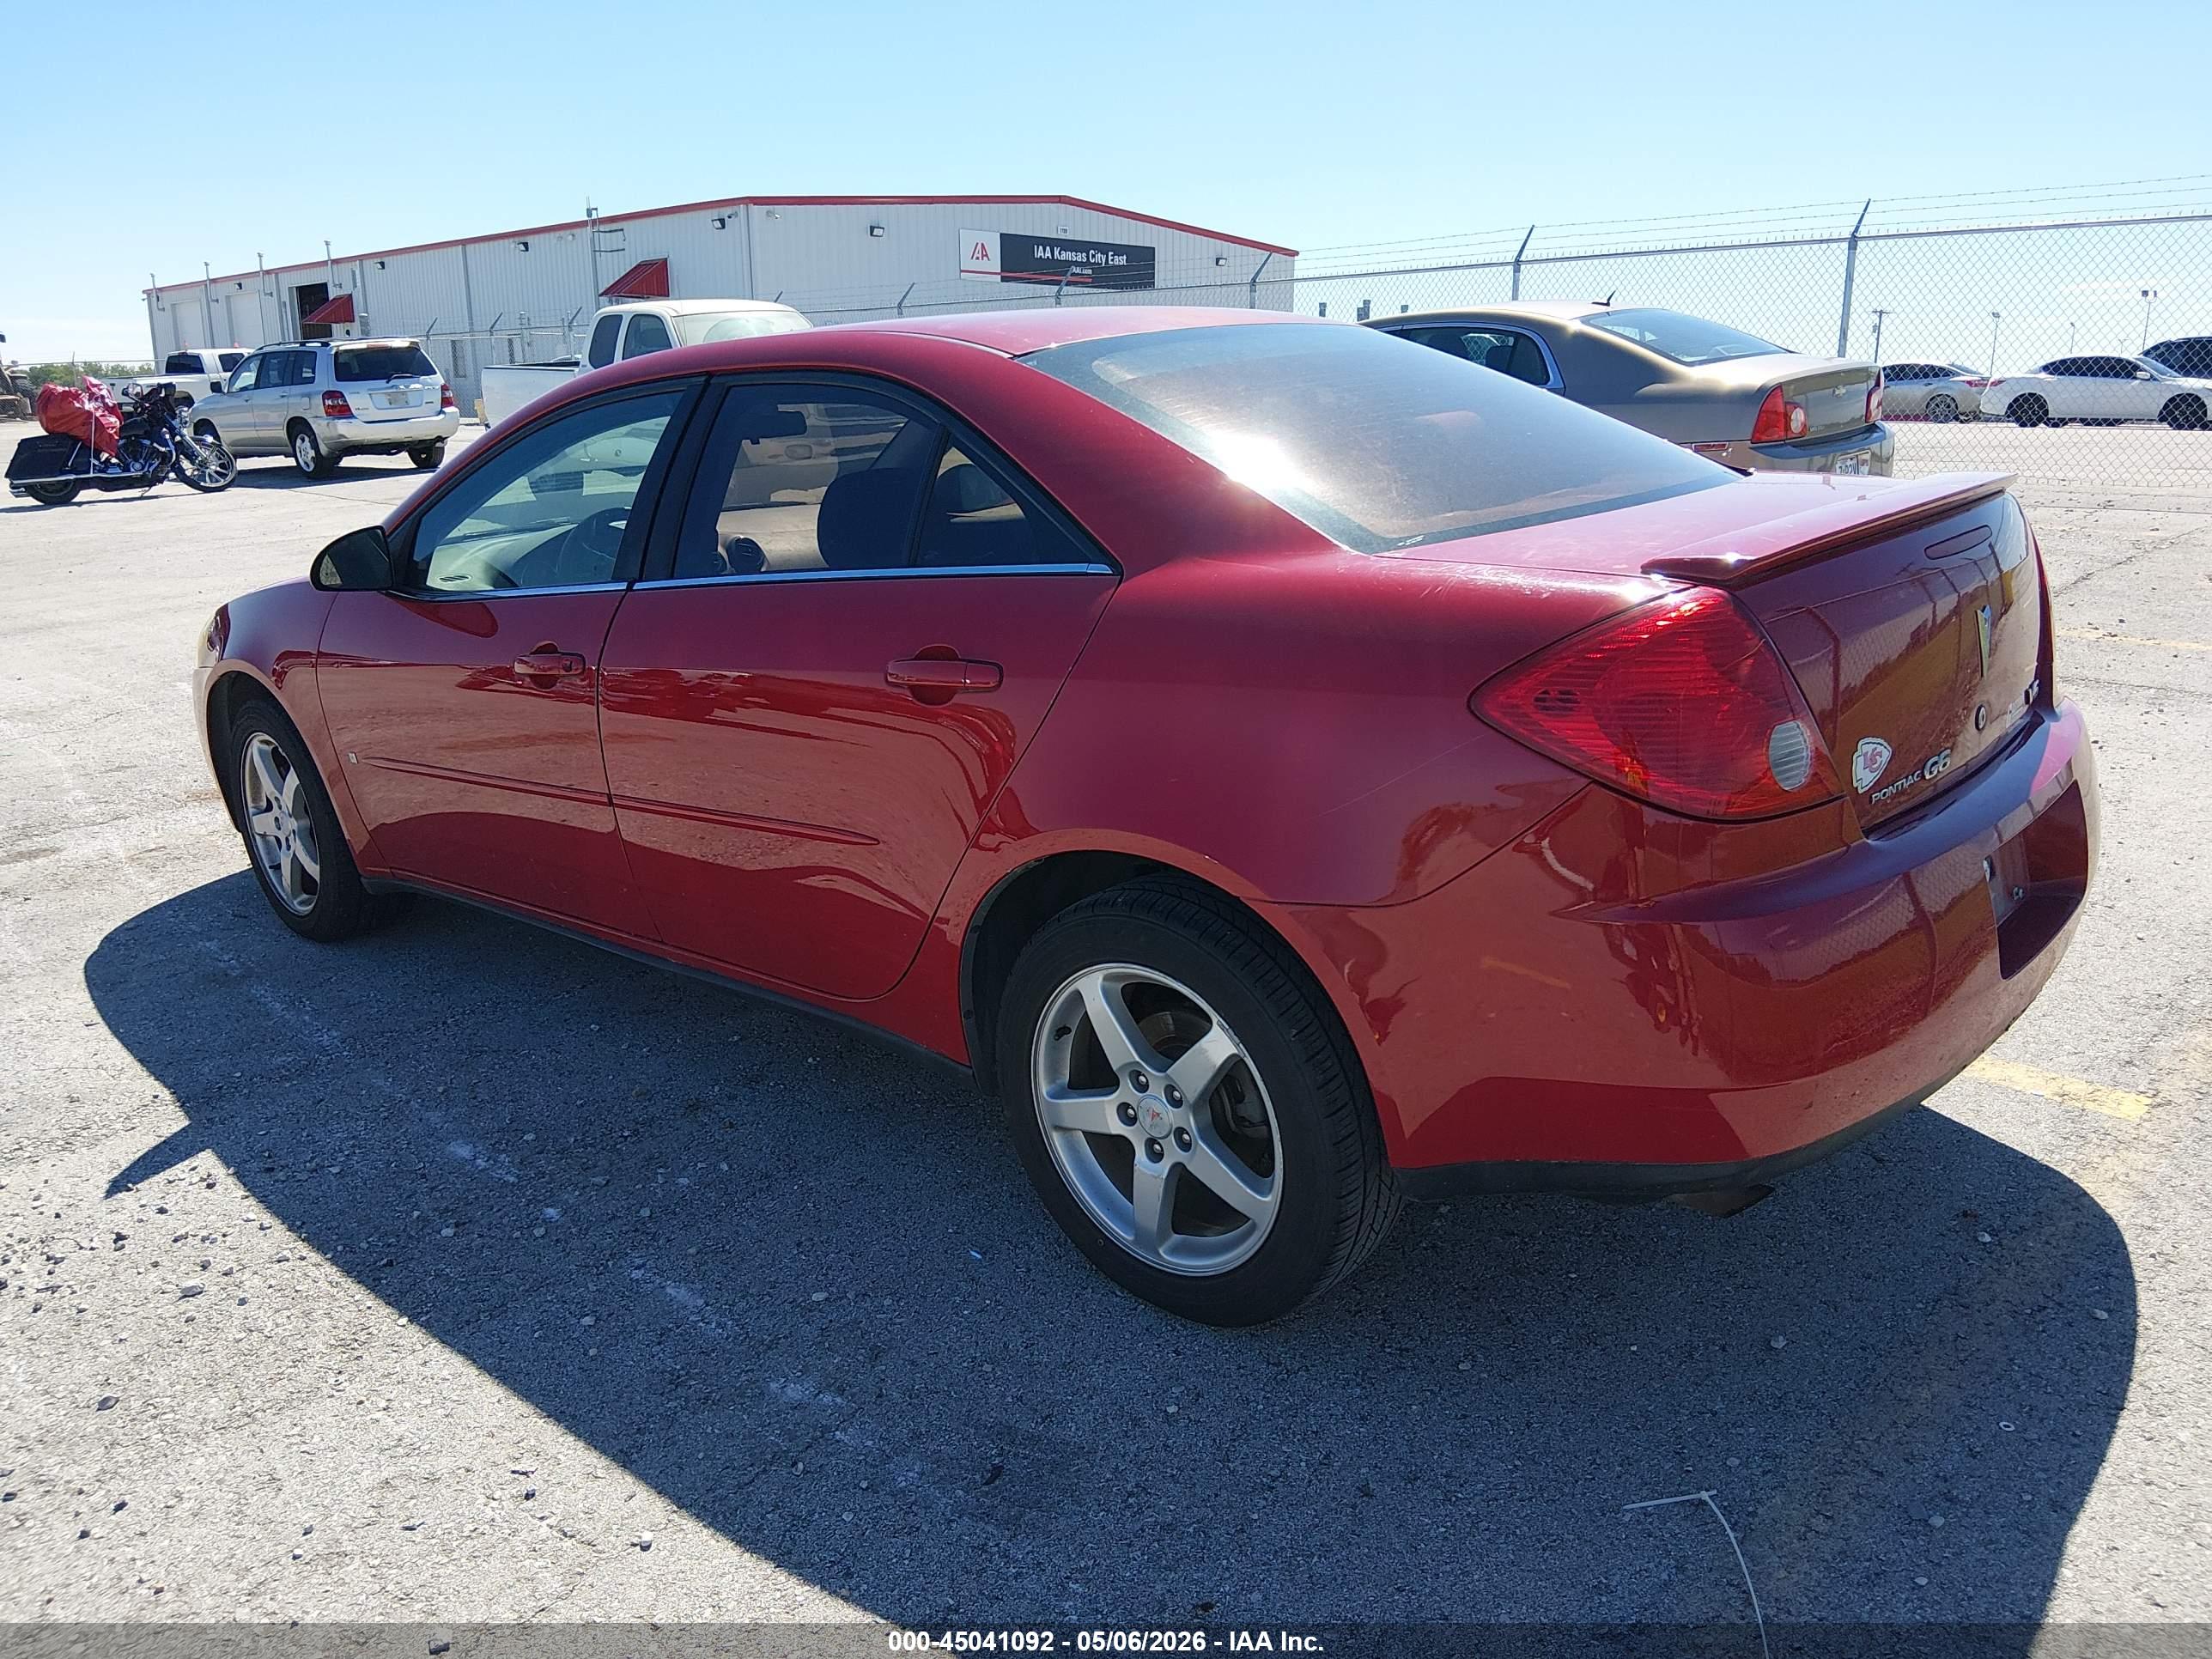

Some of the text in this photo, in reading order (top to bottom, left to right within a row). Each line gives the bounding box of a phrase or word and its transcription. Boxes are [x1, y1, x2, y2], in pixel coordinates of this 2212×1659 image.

[1034, 245, 1127, 267] IAA Kansas City East
[1870, 747, 1952, 805] PONTIAC G6
